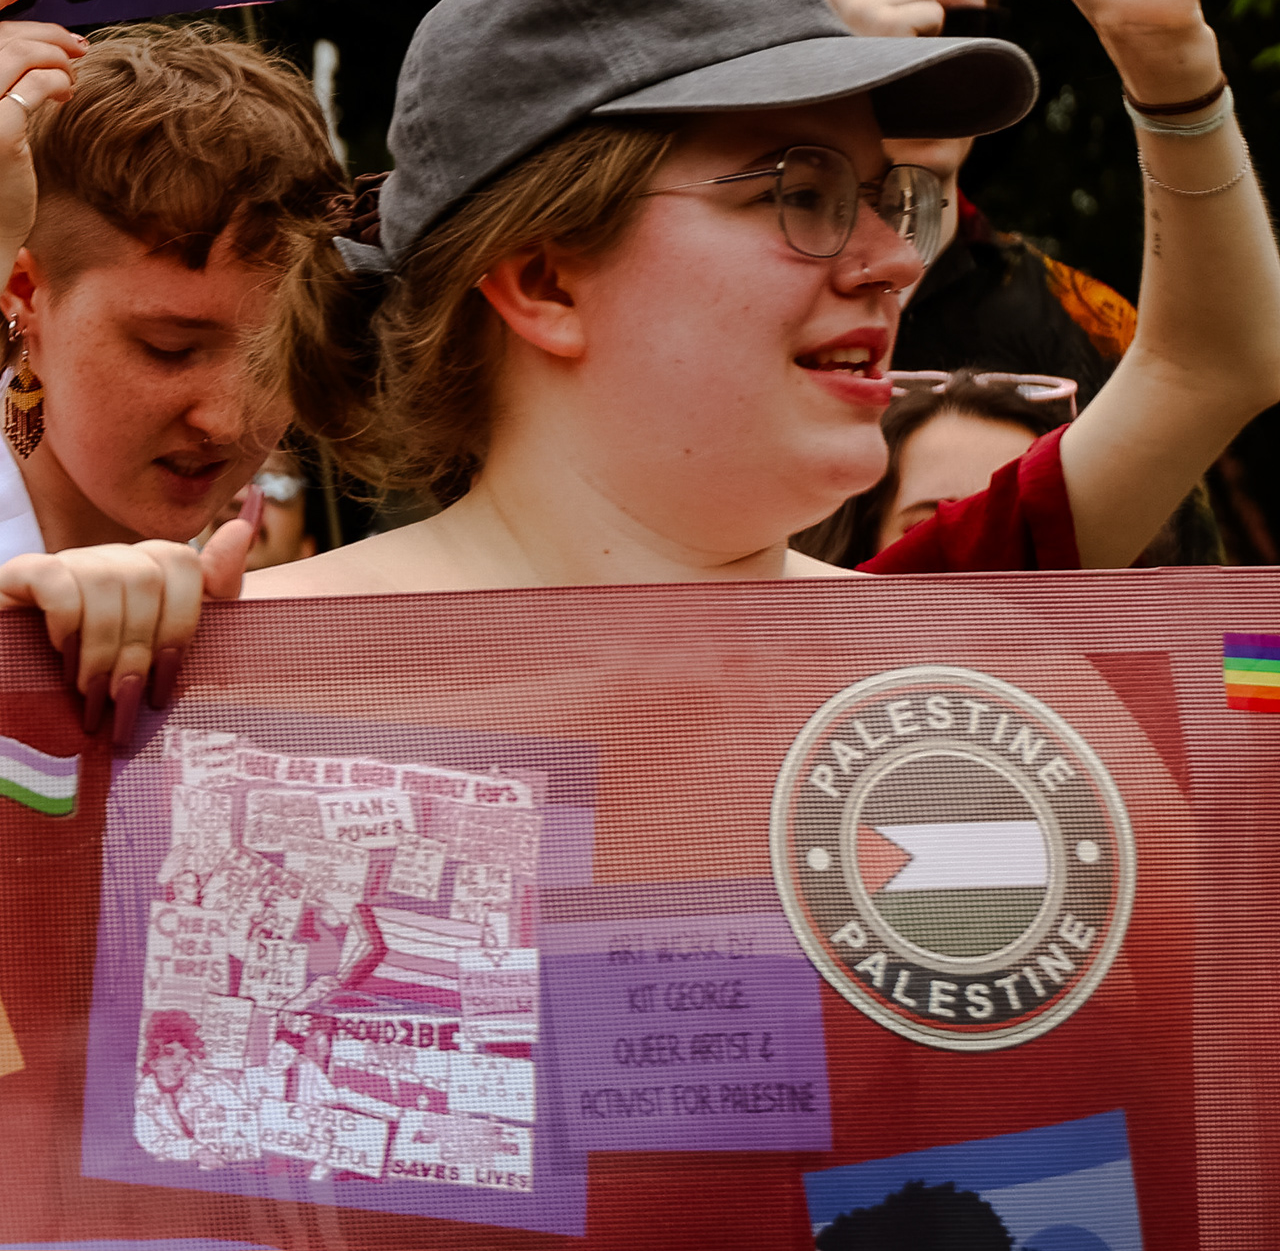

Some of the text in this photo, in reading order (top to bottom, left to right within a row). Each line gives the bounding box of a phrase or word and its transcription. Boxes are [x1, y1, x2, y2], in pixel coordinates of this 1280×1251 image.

[808, 694, 1077, 798] PALESTINE
[326, 797, 399, 820] TRANS
[338, 819, 403, 841] POWER
[830, 913, 1096, 1019] PALESTINE
